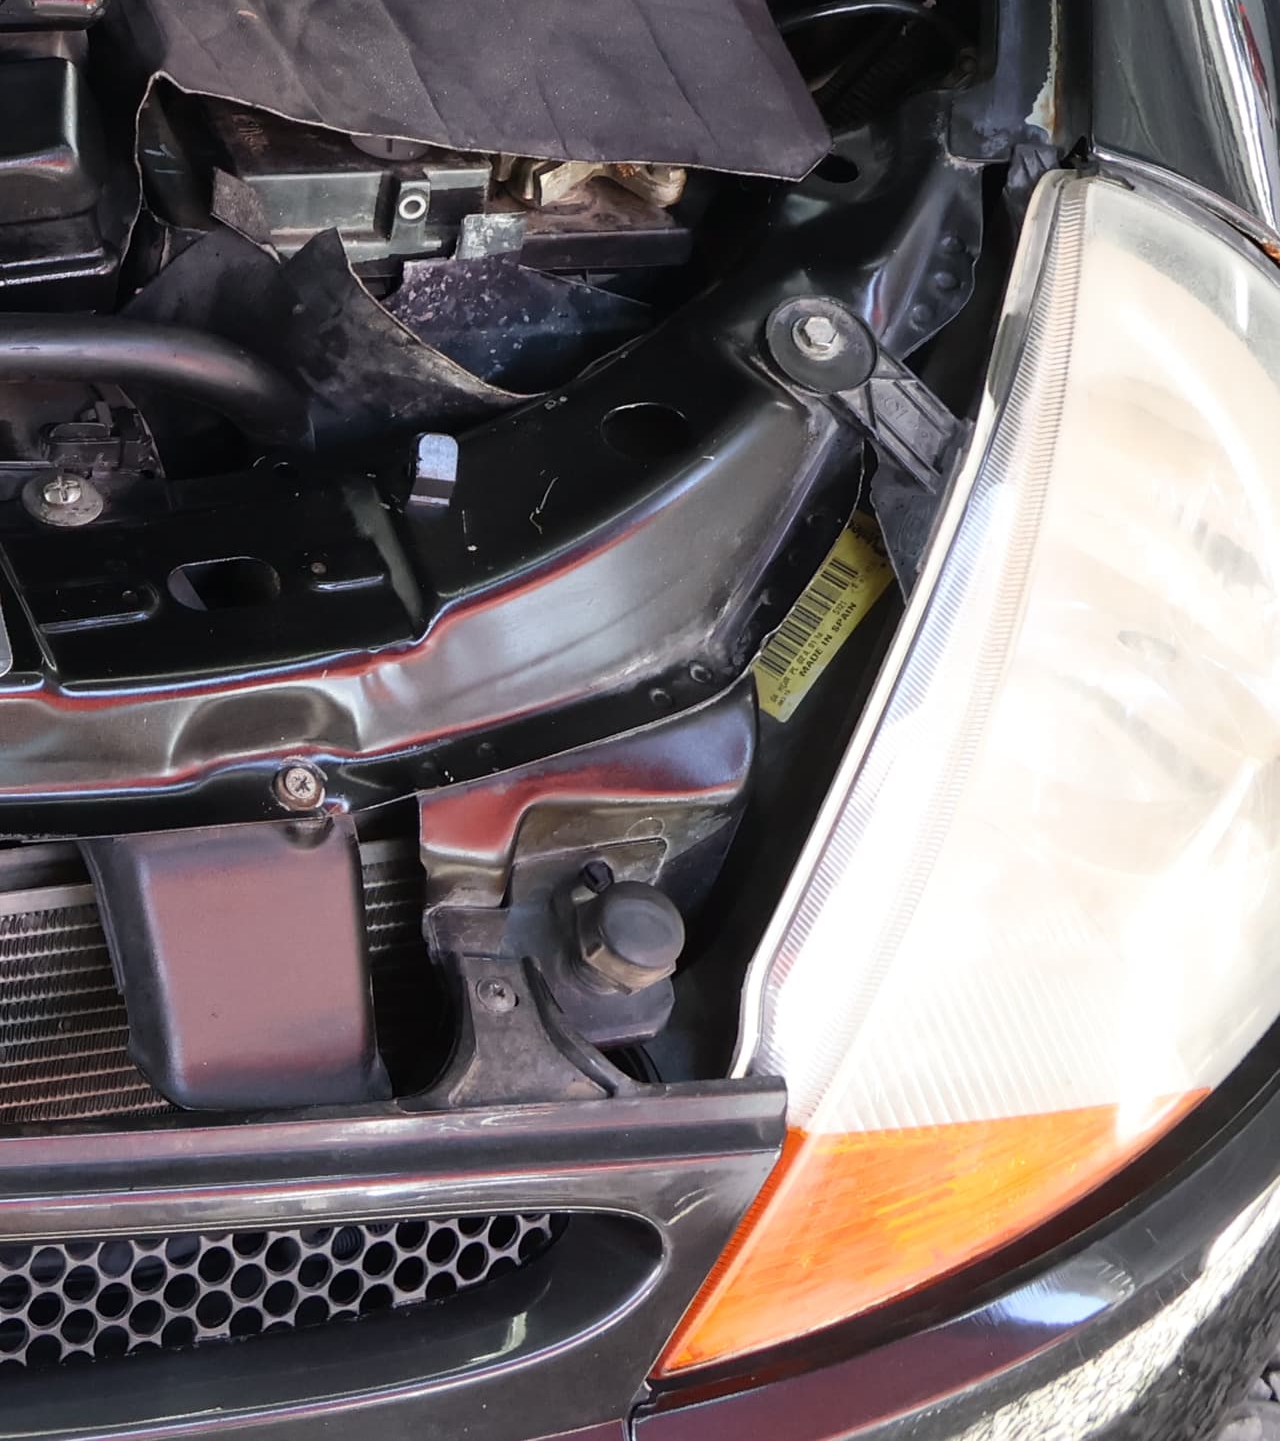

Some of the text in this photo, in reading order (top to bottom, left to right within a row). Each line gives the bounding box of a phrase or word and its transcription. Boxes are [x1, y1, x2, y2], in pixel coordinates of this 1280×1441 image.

[798, 647, 823, 677] MADE
[820, 633, 833, 646] IN
[830, 601, 857, 632] SPAIN
